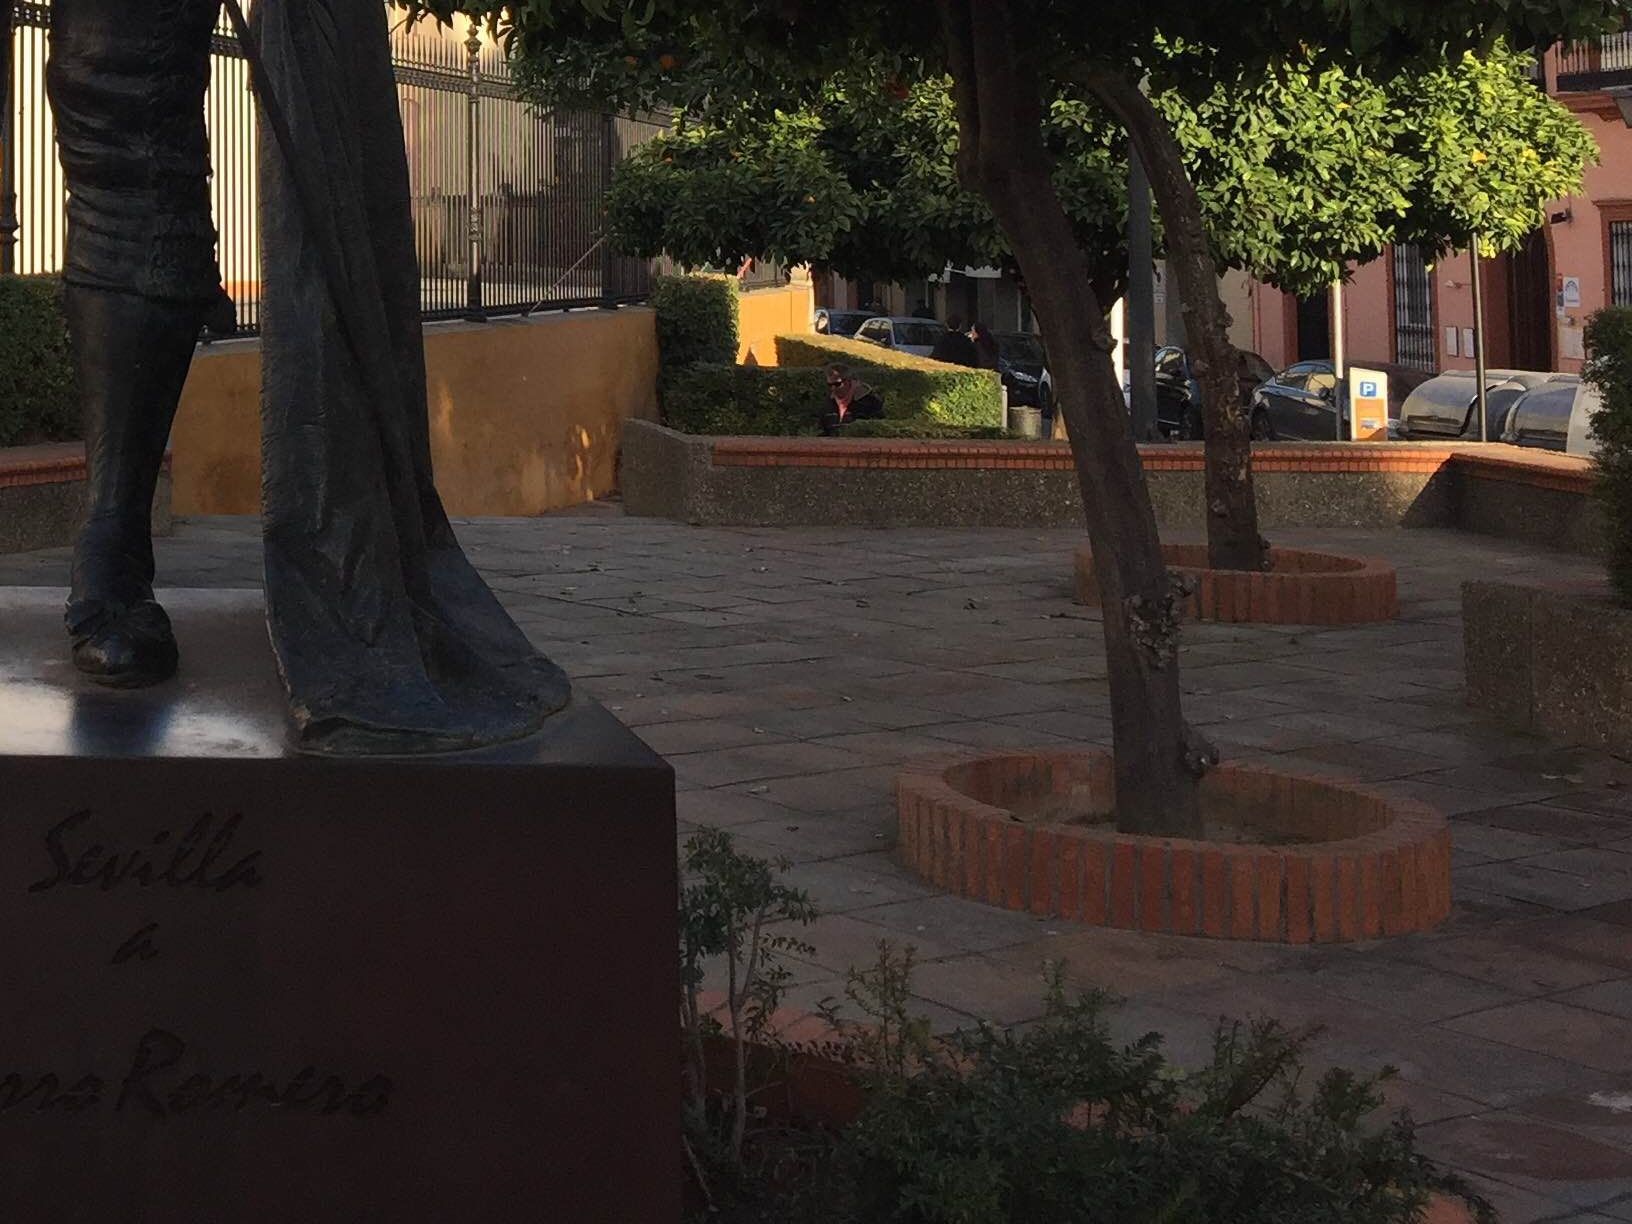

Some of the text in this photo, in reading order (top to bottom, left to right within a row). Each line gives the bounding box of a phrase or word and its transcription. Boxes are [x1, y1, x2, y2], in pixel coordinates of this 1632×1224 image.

[1363, 383, 1374, 396] P
[27, 809, 264, 893] Sevilla
[111, 921, 160, 965] a
[114, 1028, 396, 1119] Romero
